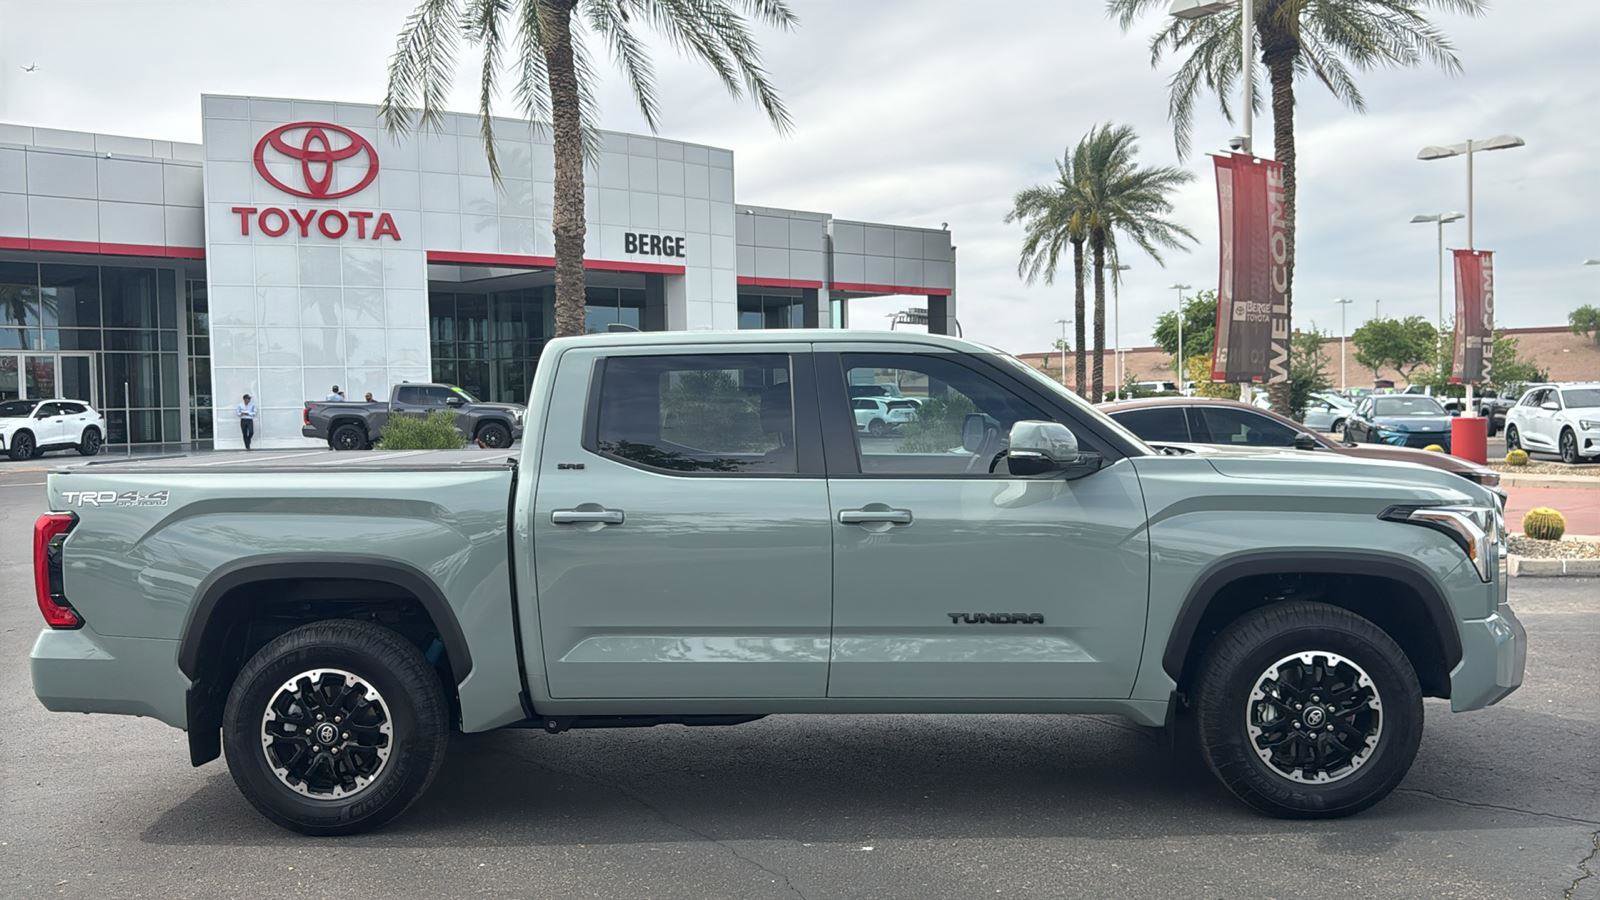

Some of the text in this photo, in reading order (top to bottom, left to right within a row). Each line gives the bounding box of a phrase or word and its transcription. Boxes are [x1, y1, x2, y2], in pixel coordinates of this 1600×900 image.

[232, 207, 401, 241] TOYOTA
[624, 232, 686, 258] BERGE
[1267, 165, 1288, 384] WELCOME
[1246, 313, 1270, 322] TOYOTA
[1481, 255, 1493, 384] WELCOME
[62, 491, 117, 507] TRD
[947, 612, 1044, 624] TUNDRA
